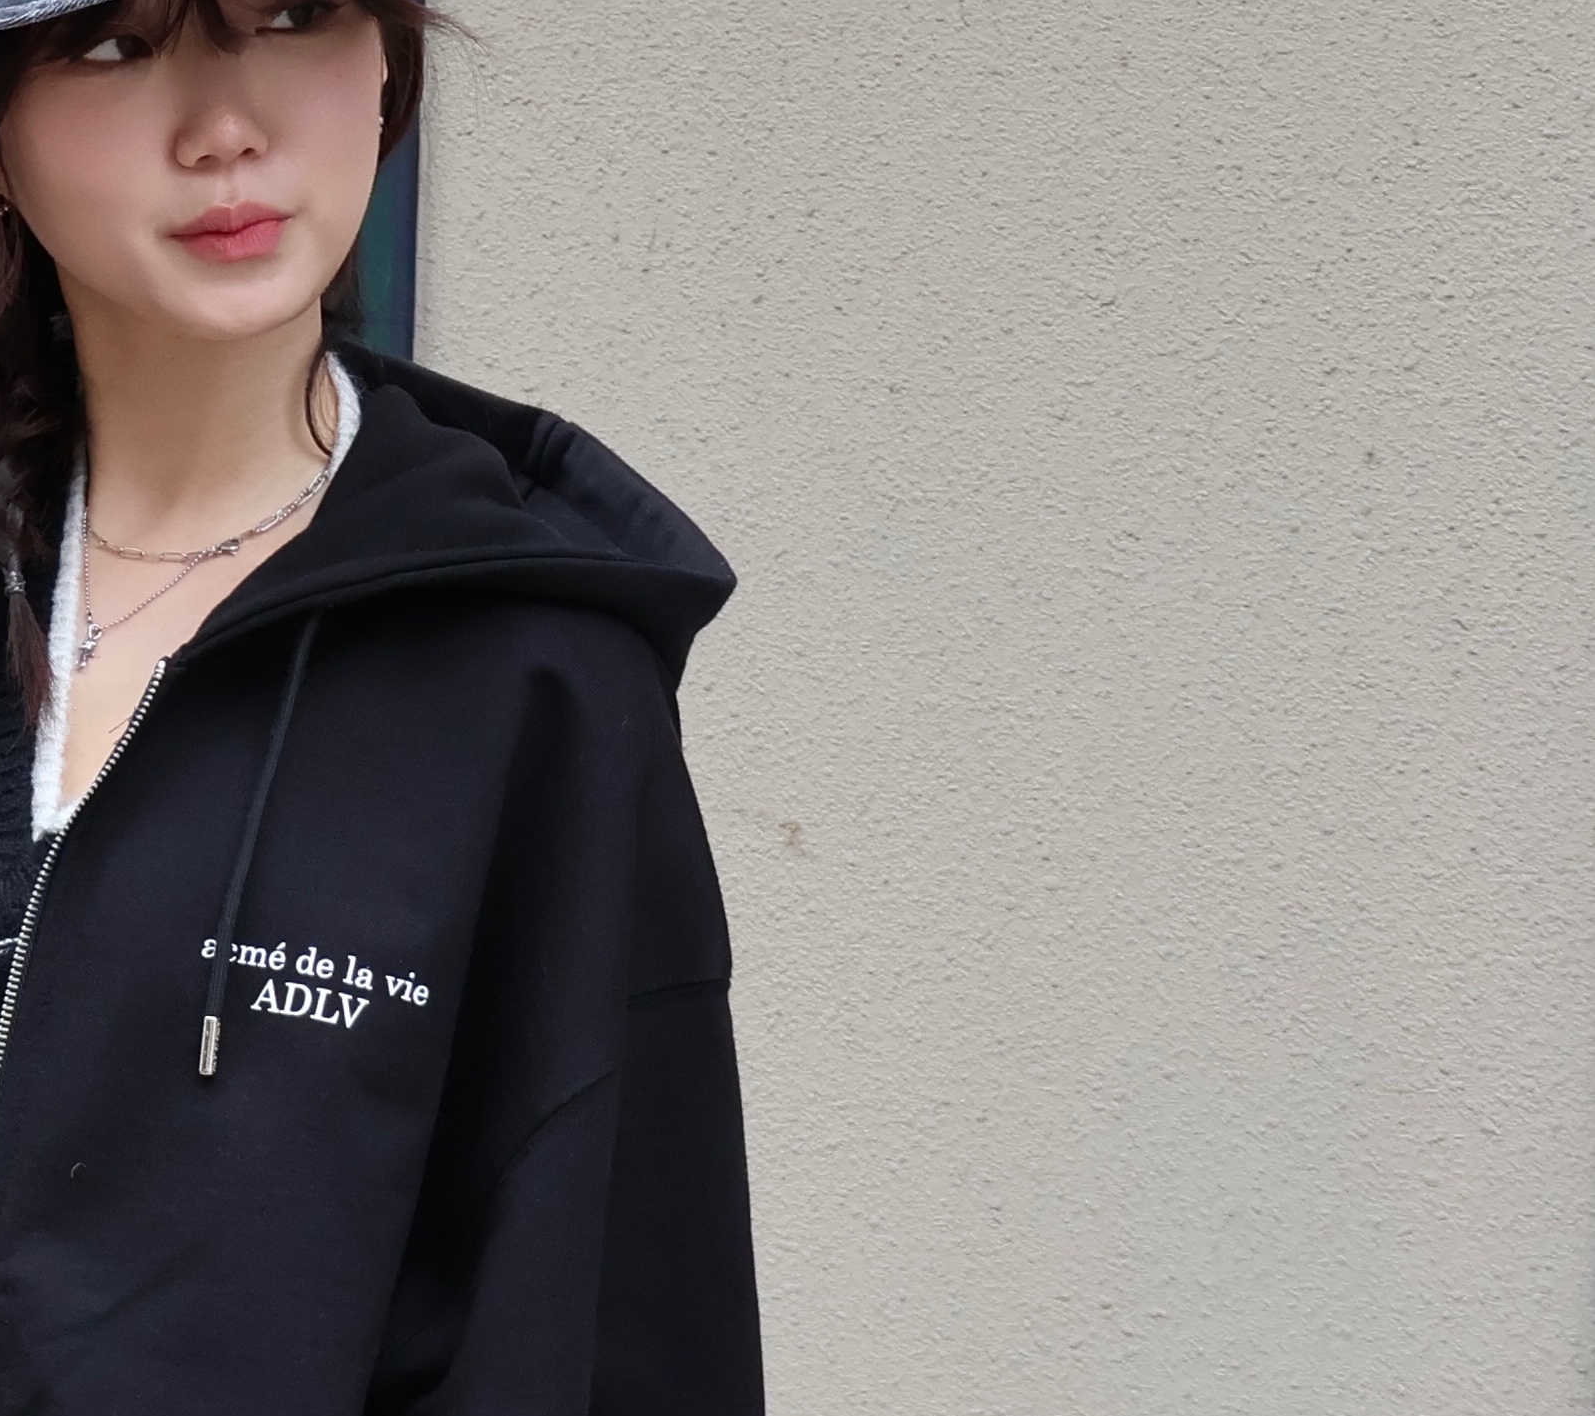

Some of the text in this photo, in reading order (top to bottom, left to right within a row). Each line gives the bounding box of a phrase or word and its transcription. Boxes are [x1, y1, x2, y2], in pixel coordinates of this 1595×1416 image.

[250, 979, 370, 1029] ADLV
[295, 947, 334, 978] de
[343, 955, 374, 991] la
[385, 972, 430, 1007] vie
